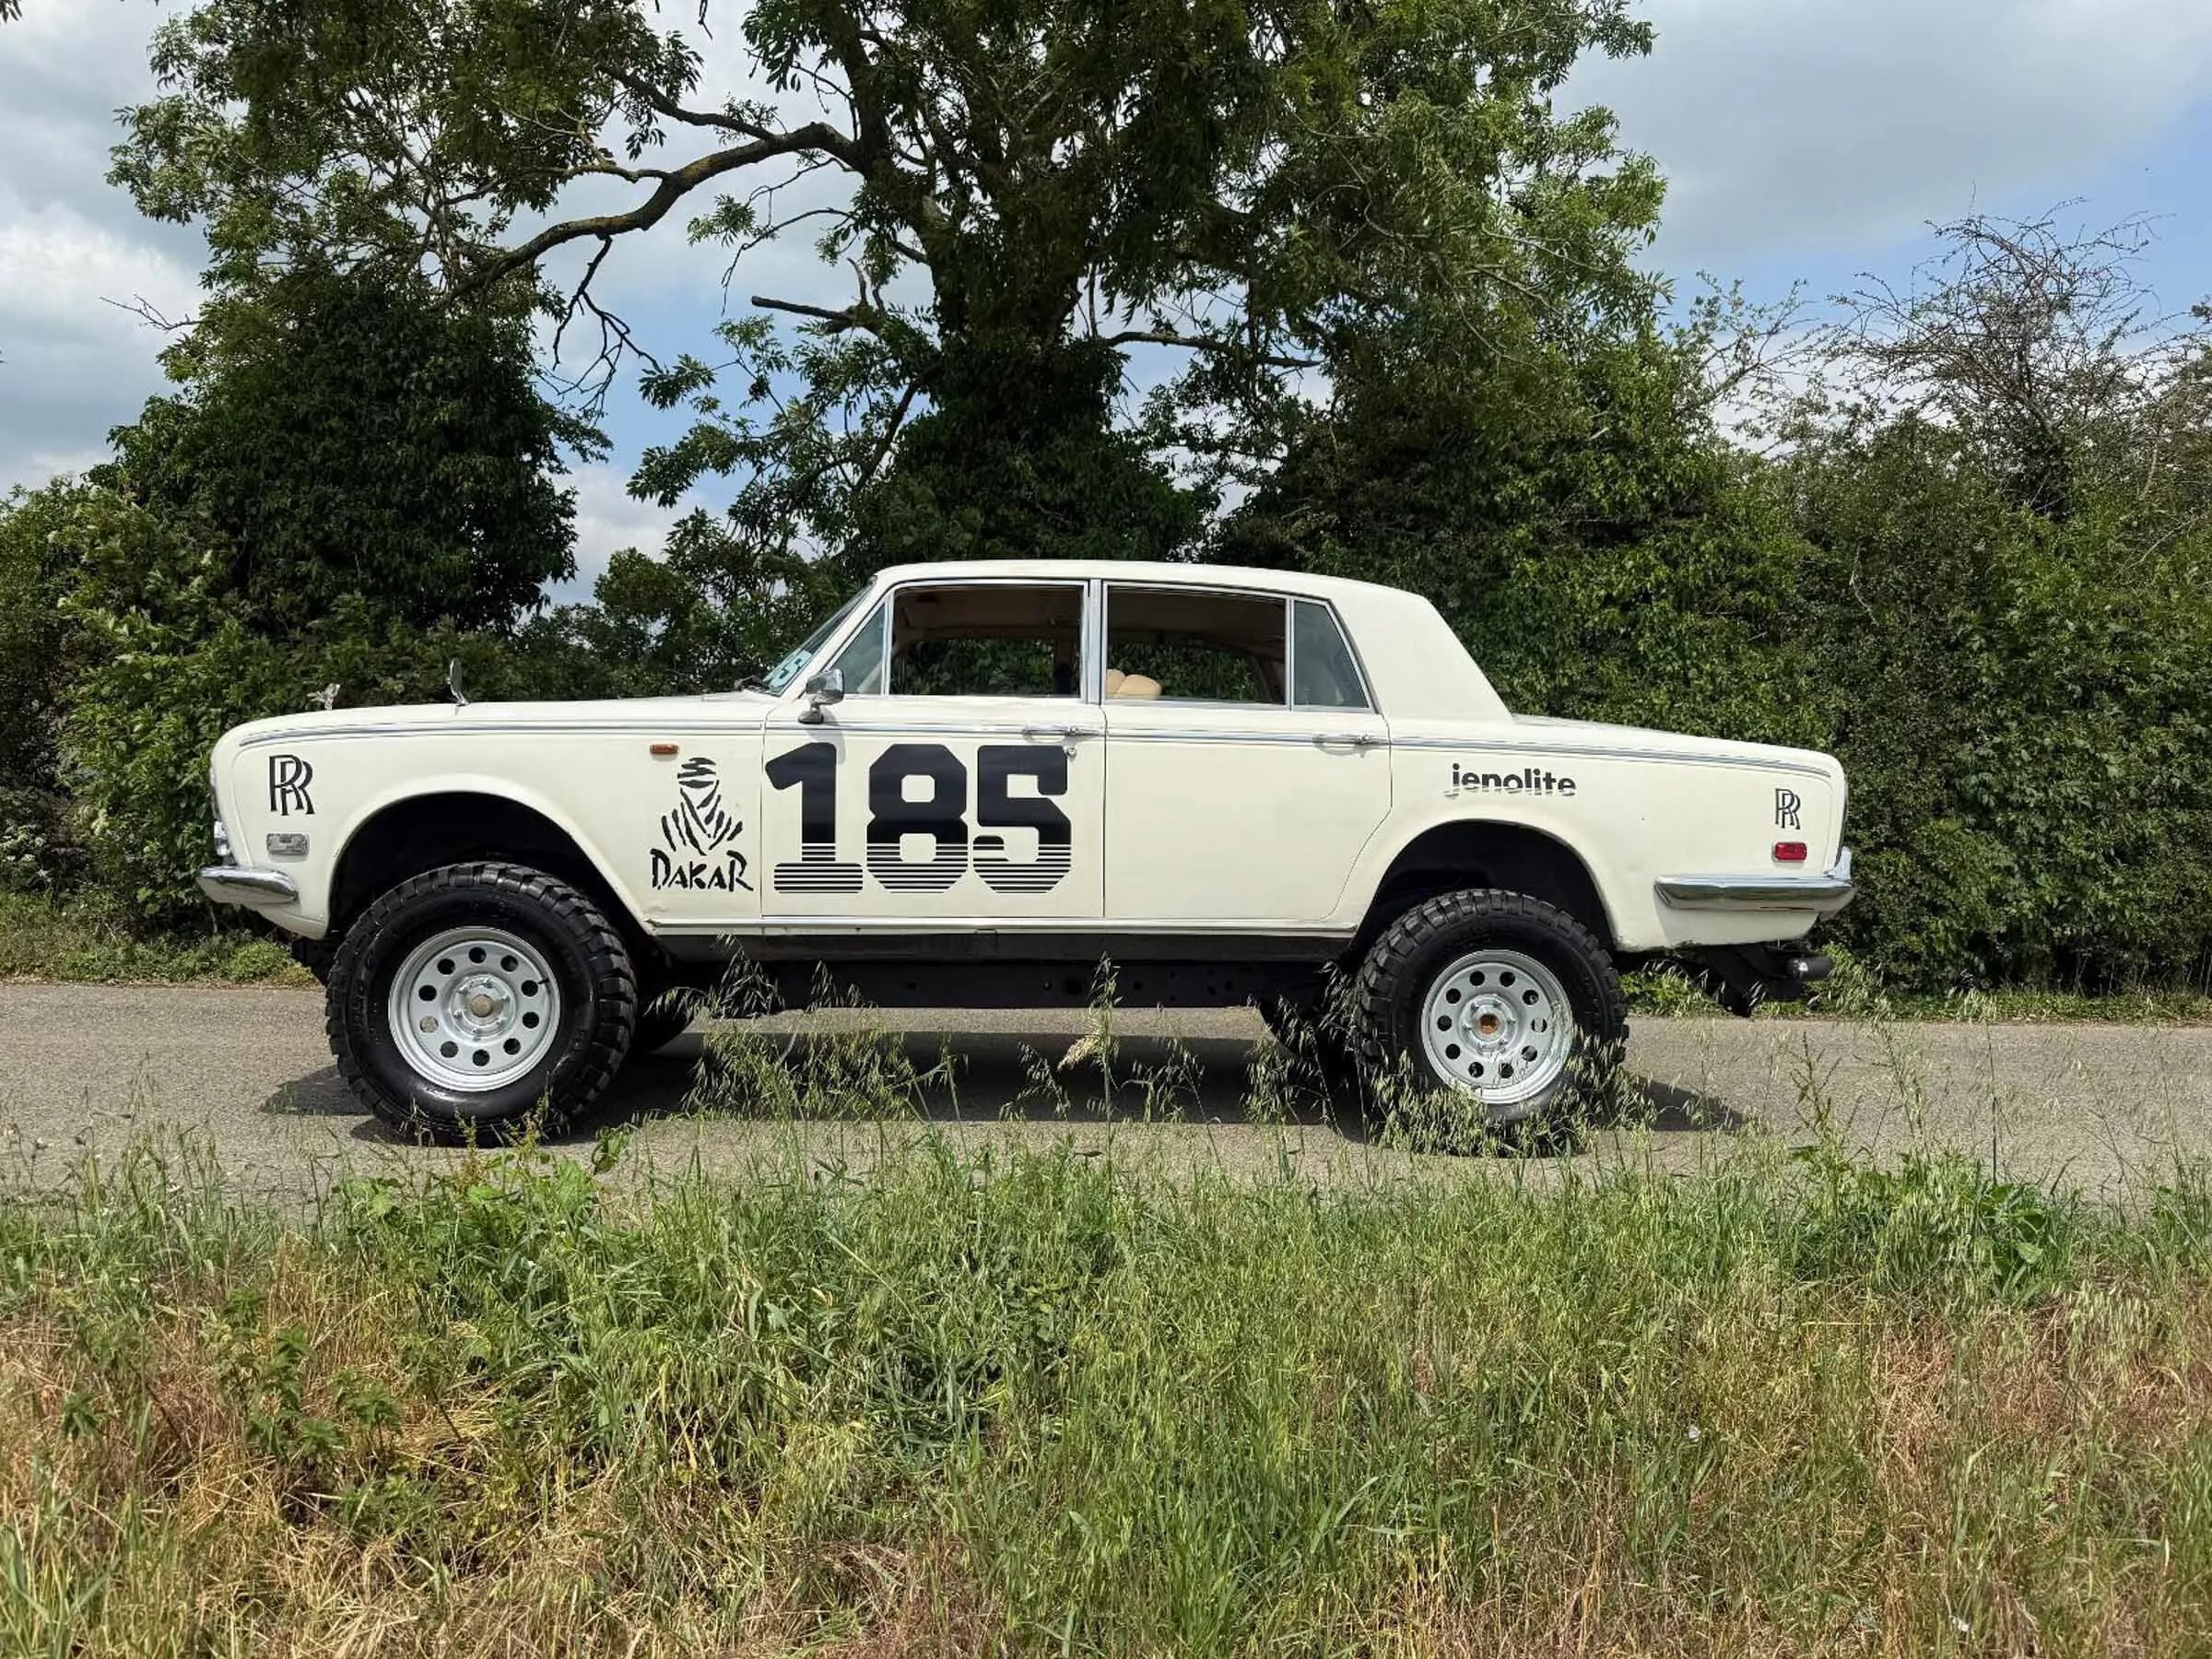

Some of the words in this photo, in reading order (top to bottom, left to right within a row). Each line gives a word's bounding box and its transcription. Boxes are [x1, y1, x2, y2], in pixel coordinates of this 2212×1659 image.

[1443, 763, 1577, 799] jenolite
[765, 742, 1071, 893] 185
[650, 848, 754, 892] DAKAR
